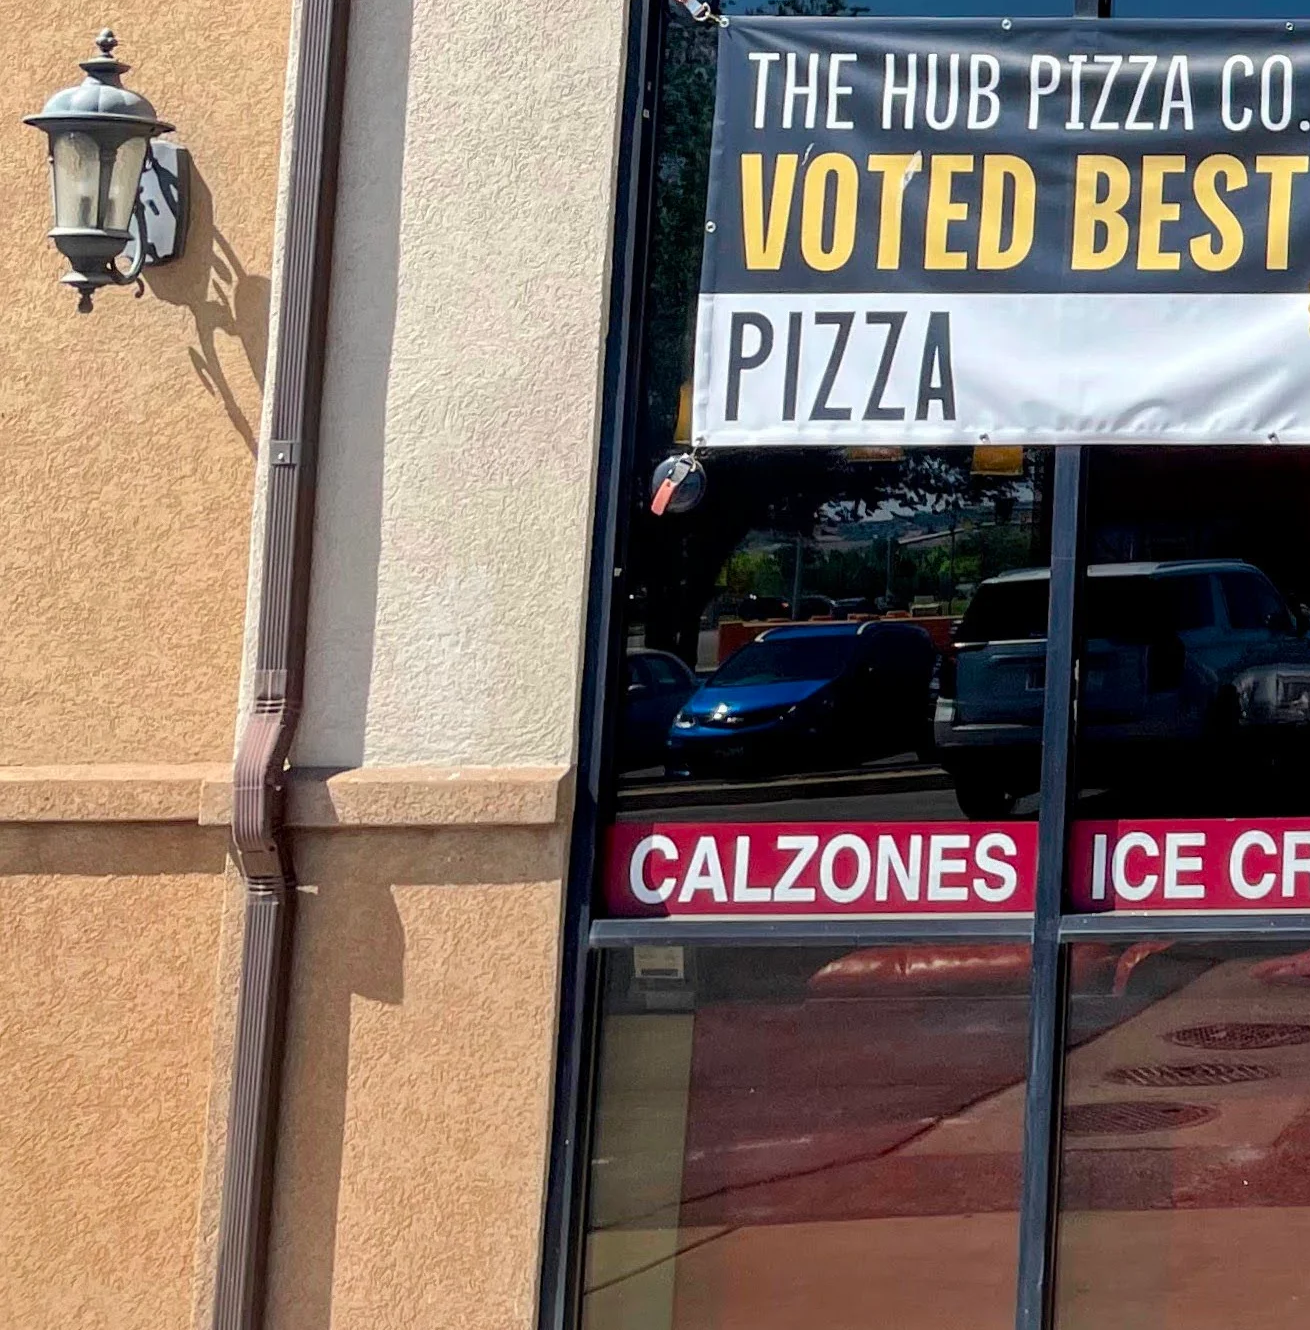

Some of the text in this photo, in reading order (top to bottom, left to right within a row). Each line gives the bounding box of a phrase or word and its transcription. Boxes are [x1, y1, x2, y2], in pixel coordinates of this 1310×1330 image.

[748, 52, 858, 130] THE
[881, 52, 1001, 130] HUB
[1027, 53, 1195, 131] PIZZA
[740, 152, 1310, 272] VOTED BEST
[724, 311, 957, 422] PIZZA
[629, 833, 1018, 905] CALZONES
[1091, 831, 1206, 901] ICE
